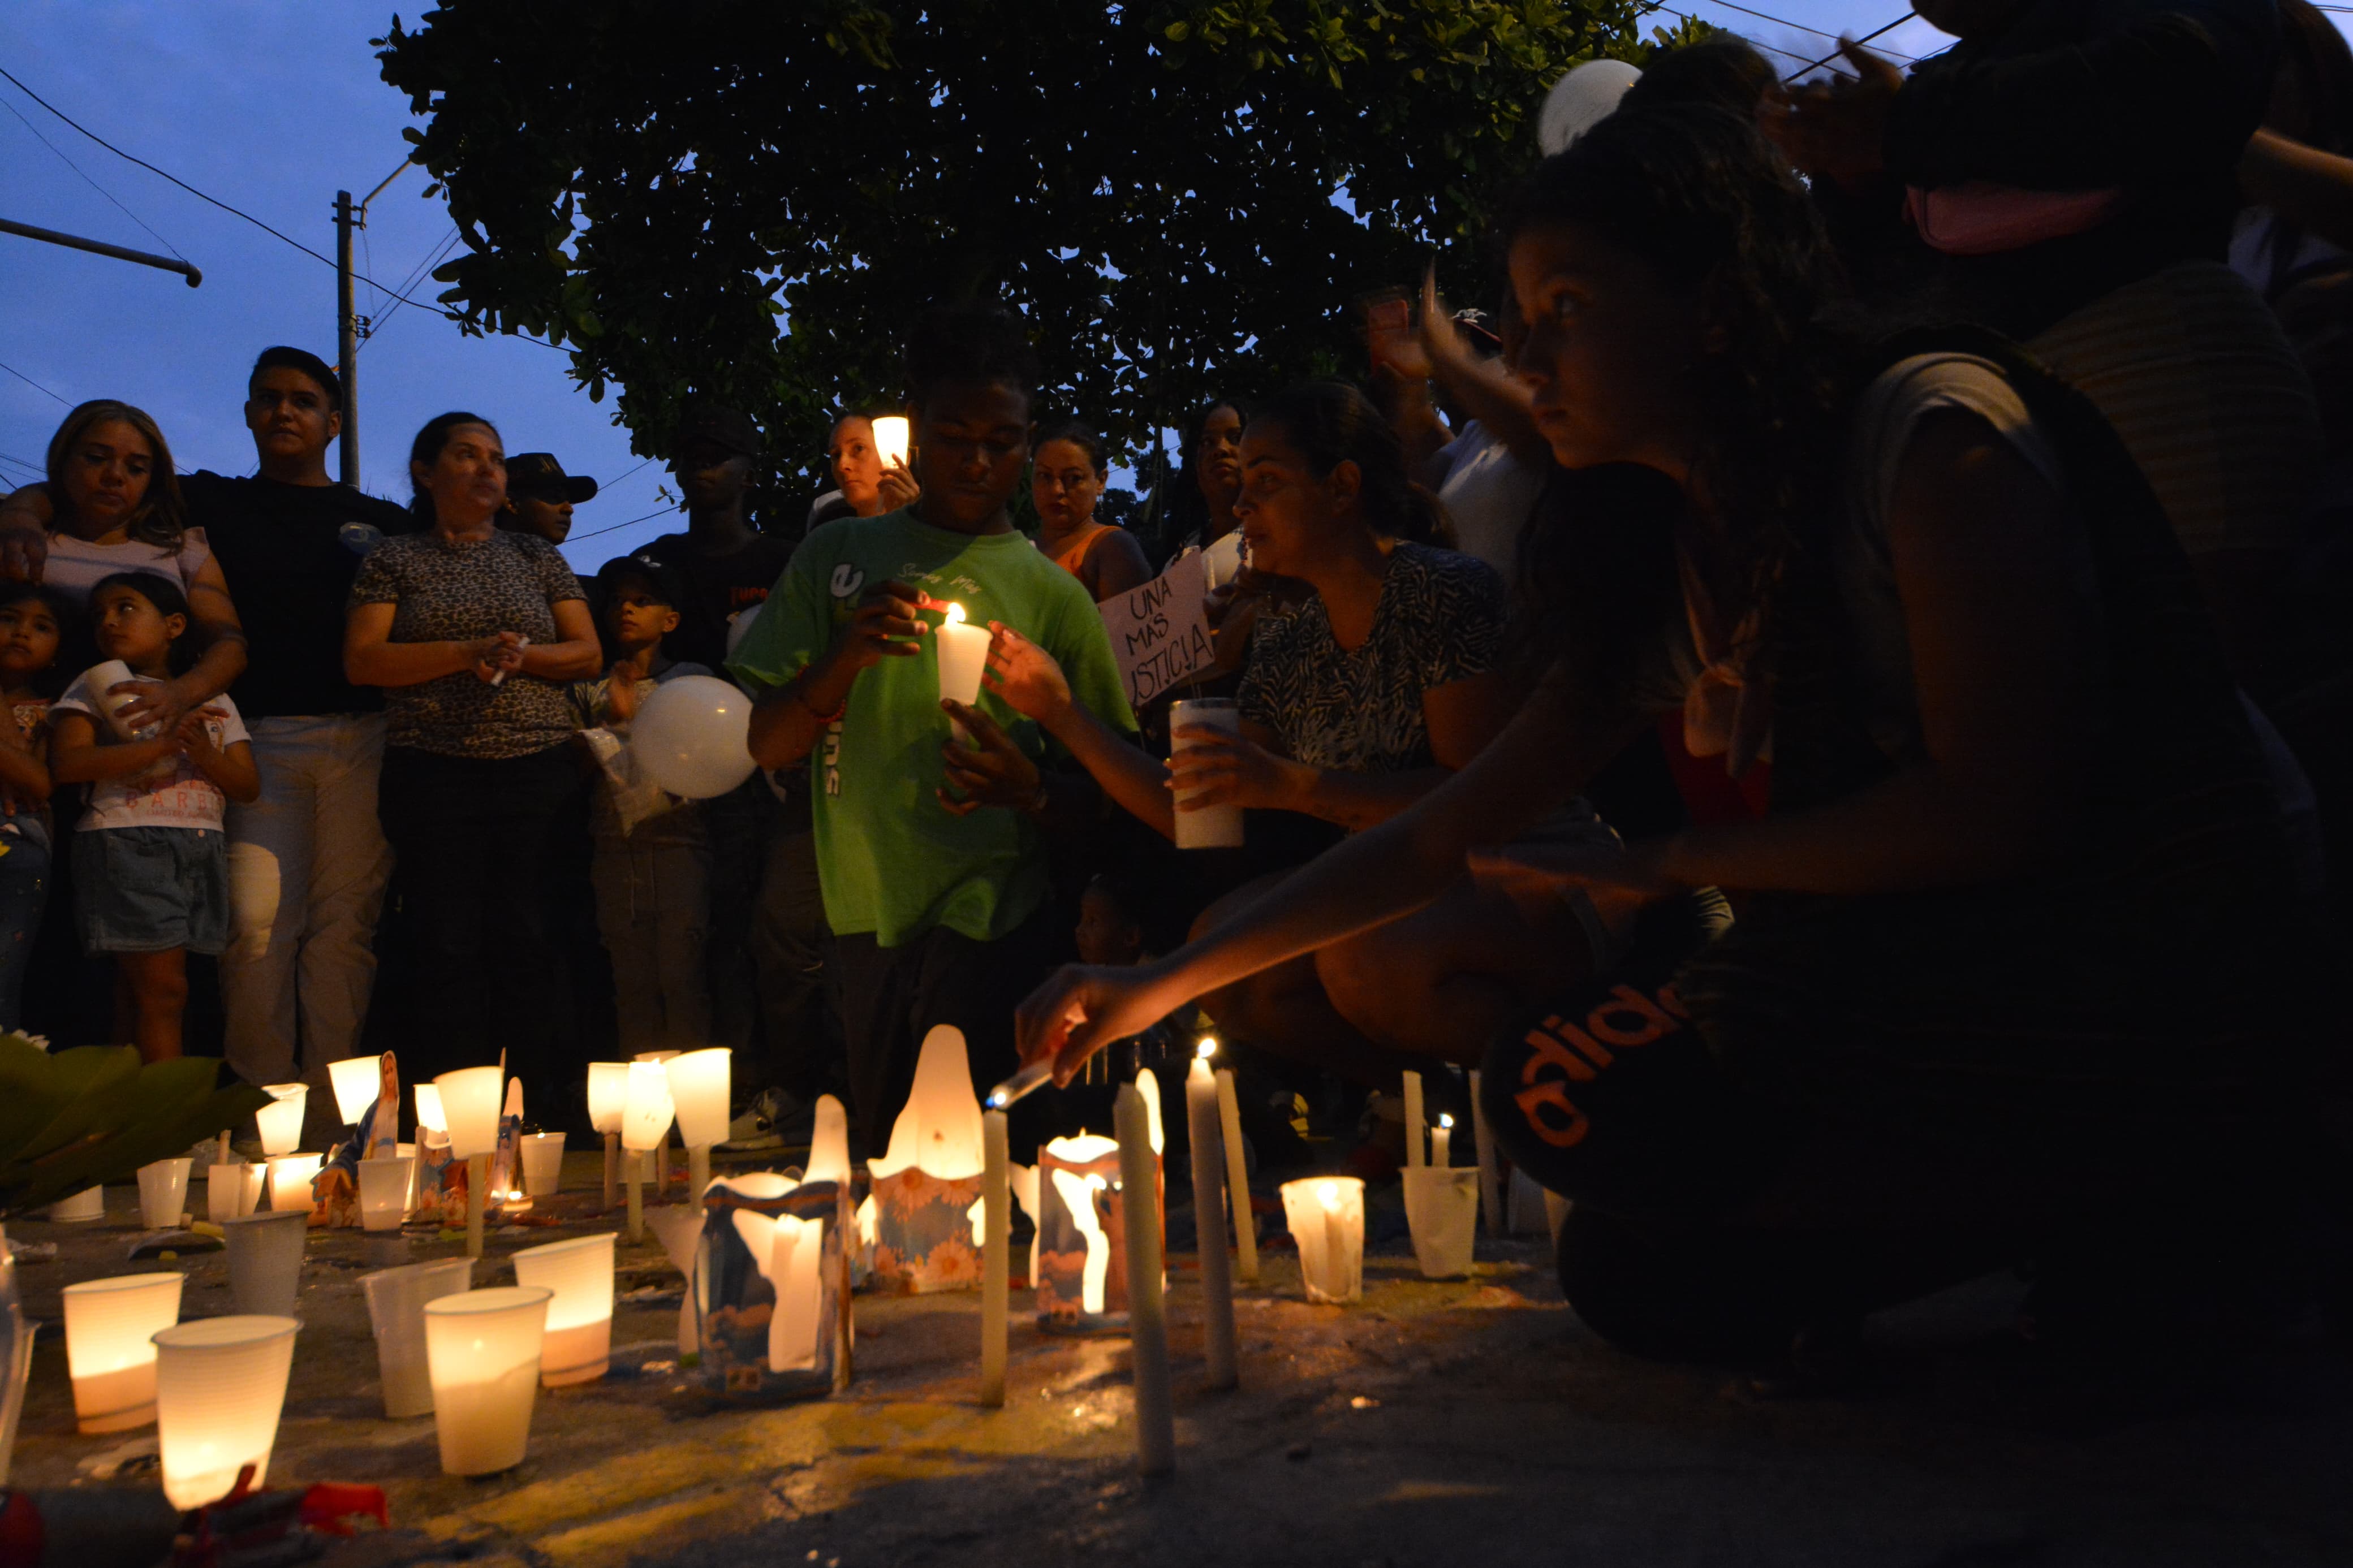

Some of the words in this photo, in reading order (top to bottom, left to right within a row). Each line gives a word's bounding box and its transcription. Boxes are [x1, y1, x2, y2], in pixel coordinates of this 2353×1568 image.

[1131, 576, 1171, 620] UNA
[1132, 624, 1213, 706] STICIA
[125, 792, 210, 811] BARB
